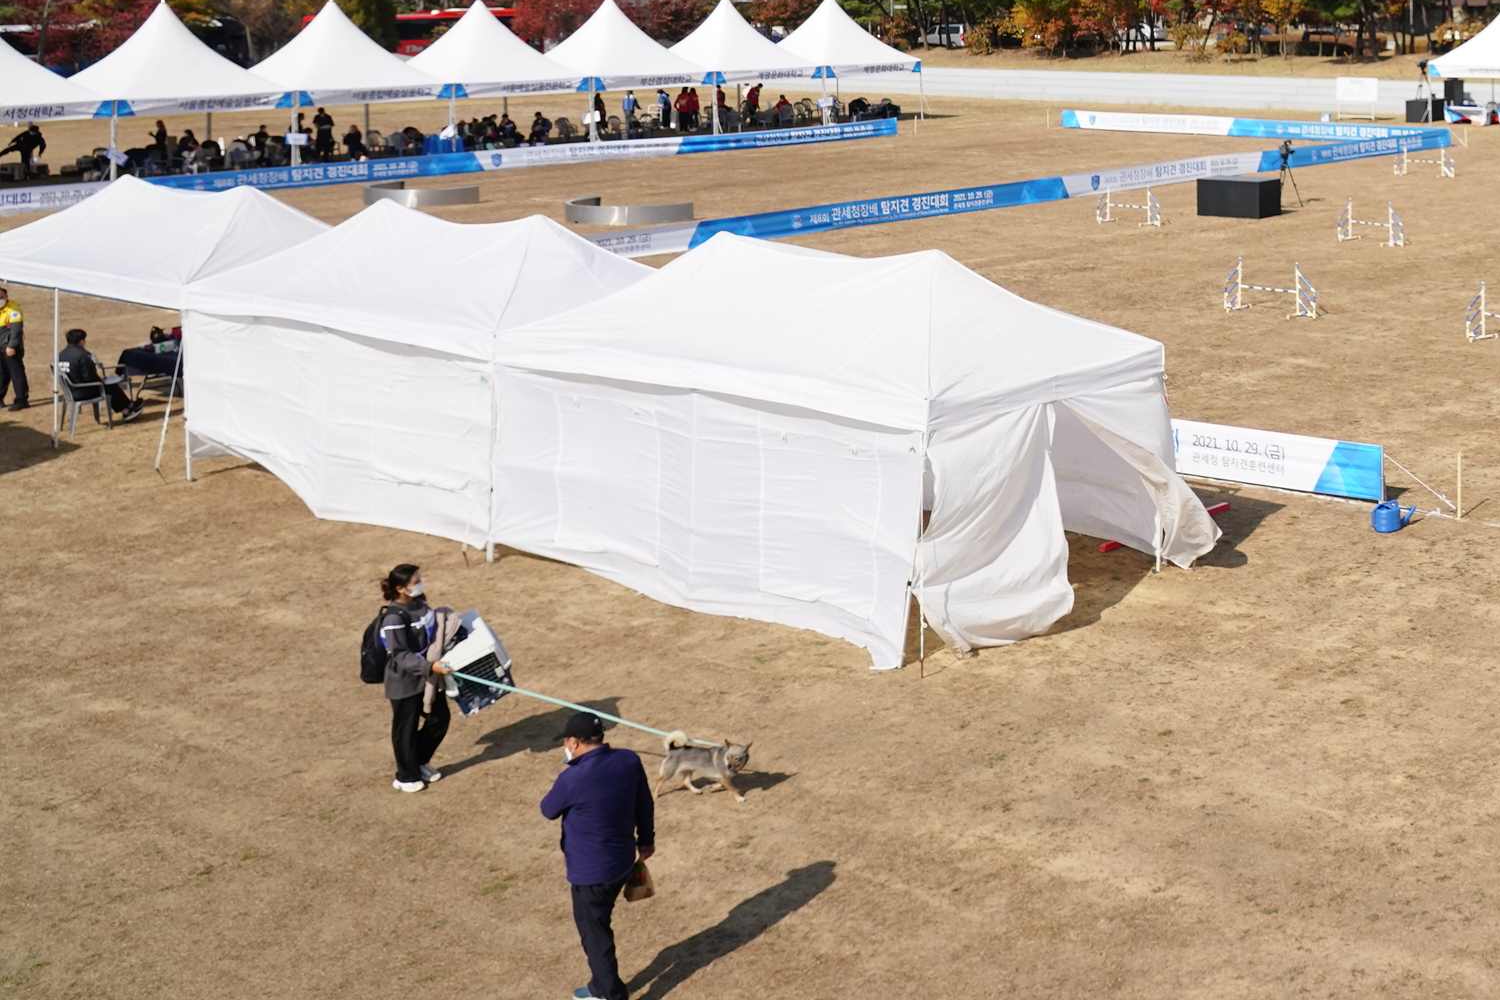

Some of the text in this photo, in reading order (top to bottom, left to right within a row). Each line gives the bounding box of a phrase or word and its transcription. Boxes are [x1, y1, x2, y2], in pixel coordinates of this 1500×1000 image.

[4, 106, 64, 119] 서정대학교
[291, 166, 324, 182] 탐지견
[326, 163, 369, 179] 경진대회
[831, 201, 879, 221] 관세청장배
[880, 197, 910, 216] 탐지견
[911, 193, 949, 212] 경진대회
[1192, 433, 1286, 460] 2021. 10. 29. (금)
